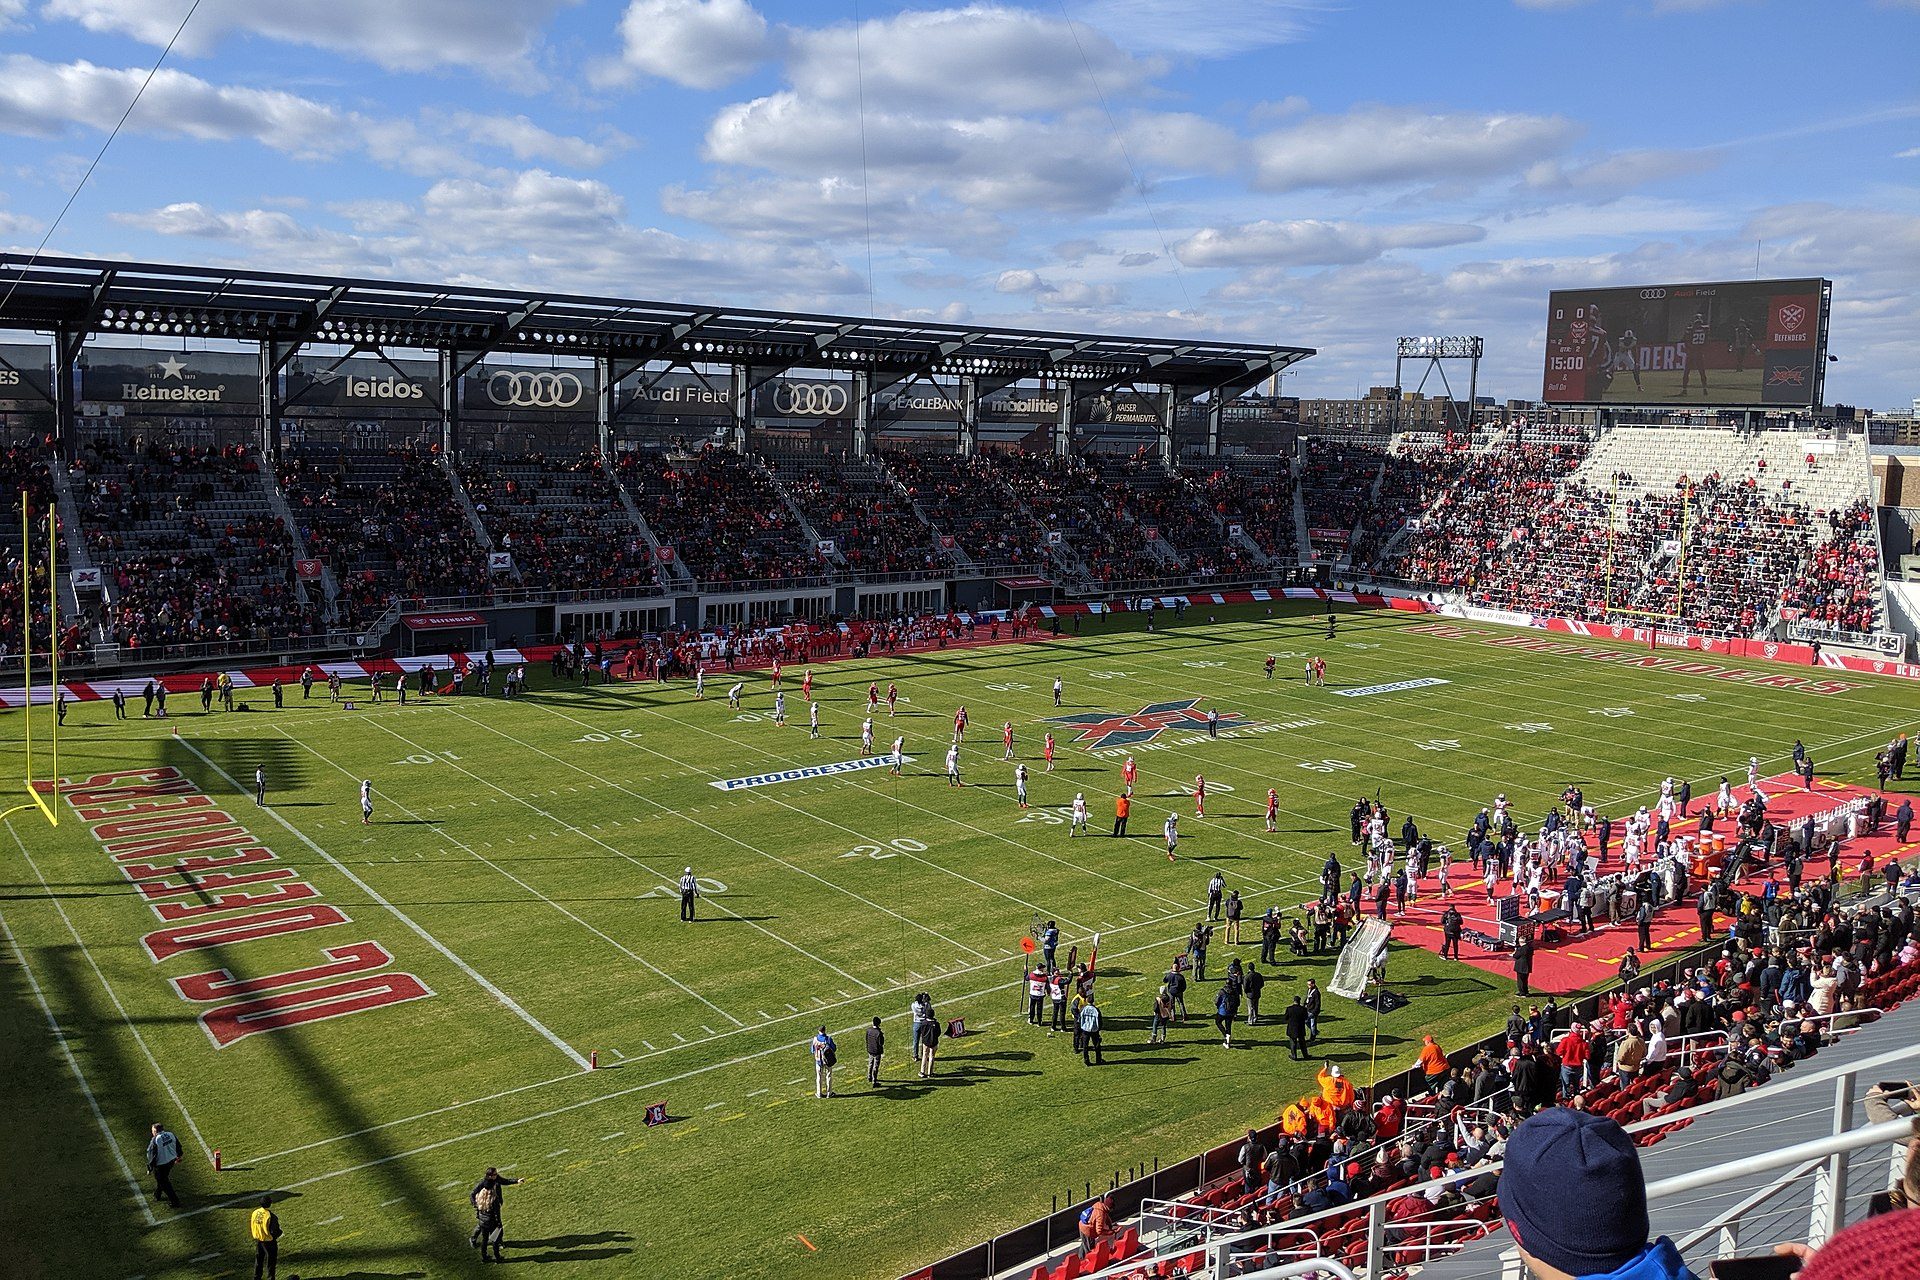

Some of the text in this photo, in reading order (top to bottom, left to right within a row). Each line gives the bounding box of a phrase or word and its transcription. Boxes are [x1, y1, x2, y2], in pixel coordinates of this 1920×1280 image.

[1695, 289, 1716, 297] Field
[1774, 333, 1807, 342] DEFENDERS
[1550, 356, 1584, 370] 15:00
[122, 383, 221, 402] Heineken
[346, 374, 424, 399] leidos
[632, 385, 730, 403] Audi Field
[991, 399, 1059, 413] mobilitie
[1116, 403, 1137, 413] KAISER
[1880, 636, 1897, 649] 25
[1131, 741, 1172, 753] THE
[1242, 718, 1328, 736] FOOTBALL
[726, 755, 898, 790] PROGRESSIVE
[1296, 759, 1356, 773] 50
[853, 838, 928, 860] 20
[25, 766, 353, 965] DEFENDERS
[653, 1107, 663, 1122] G
